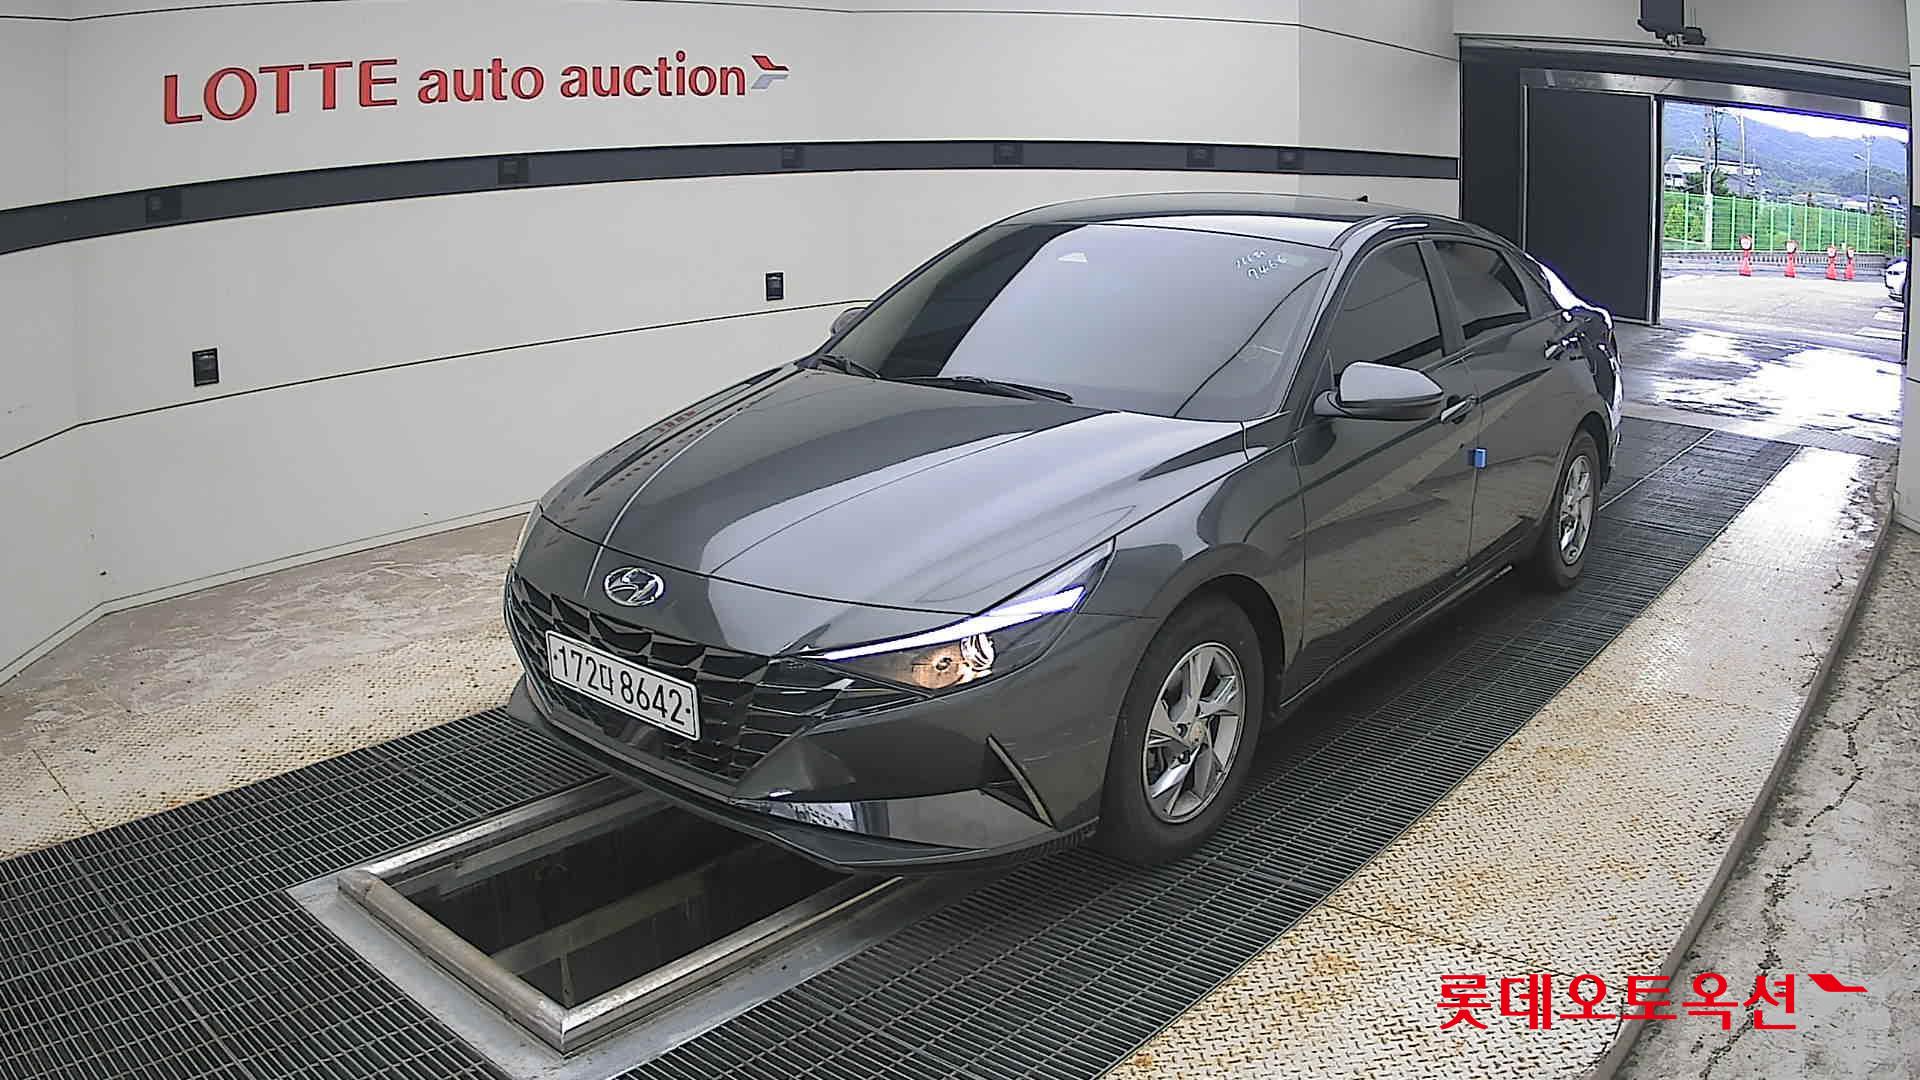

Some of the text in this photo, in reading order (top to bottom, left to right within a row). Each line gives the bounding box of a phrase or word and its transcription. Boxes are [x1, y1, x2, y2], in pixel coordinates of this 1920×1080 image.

[164, 50, 746, 124] LOTTE auto auction
